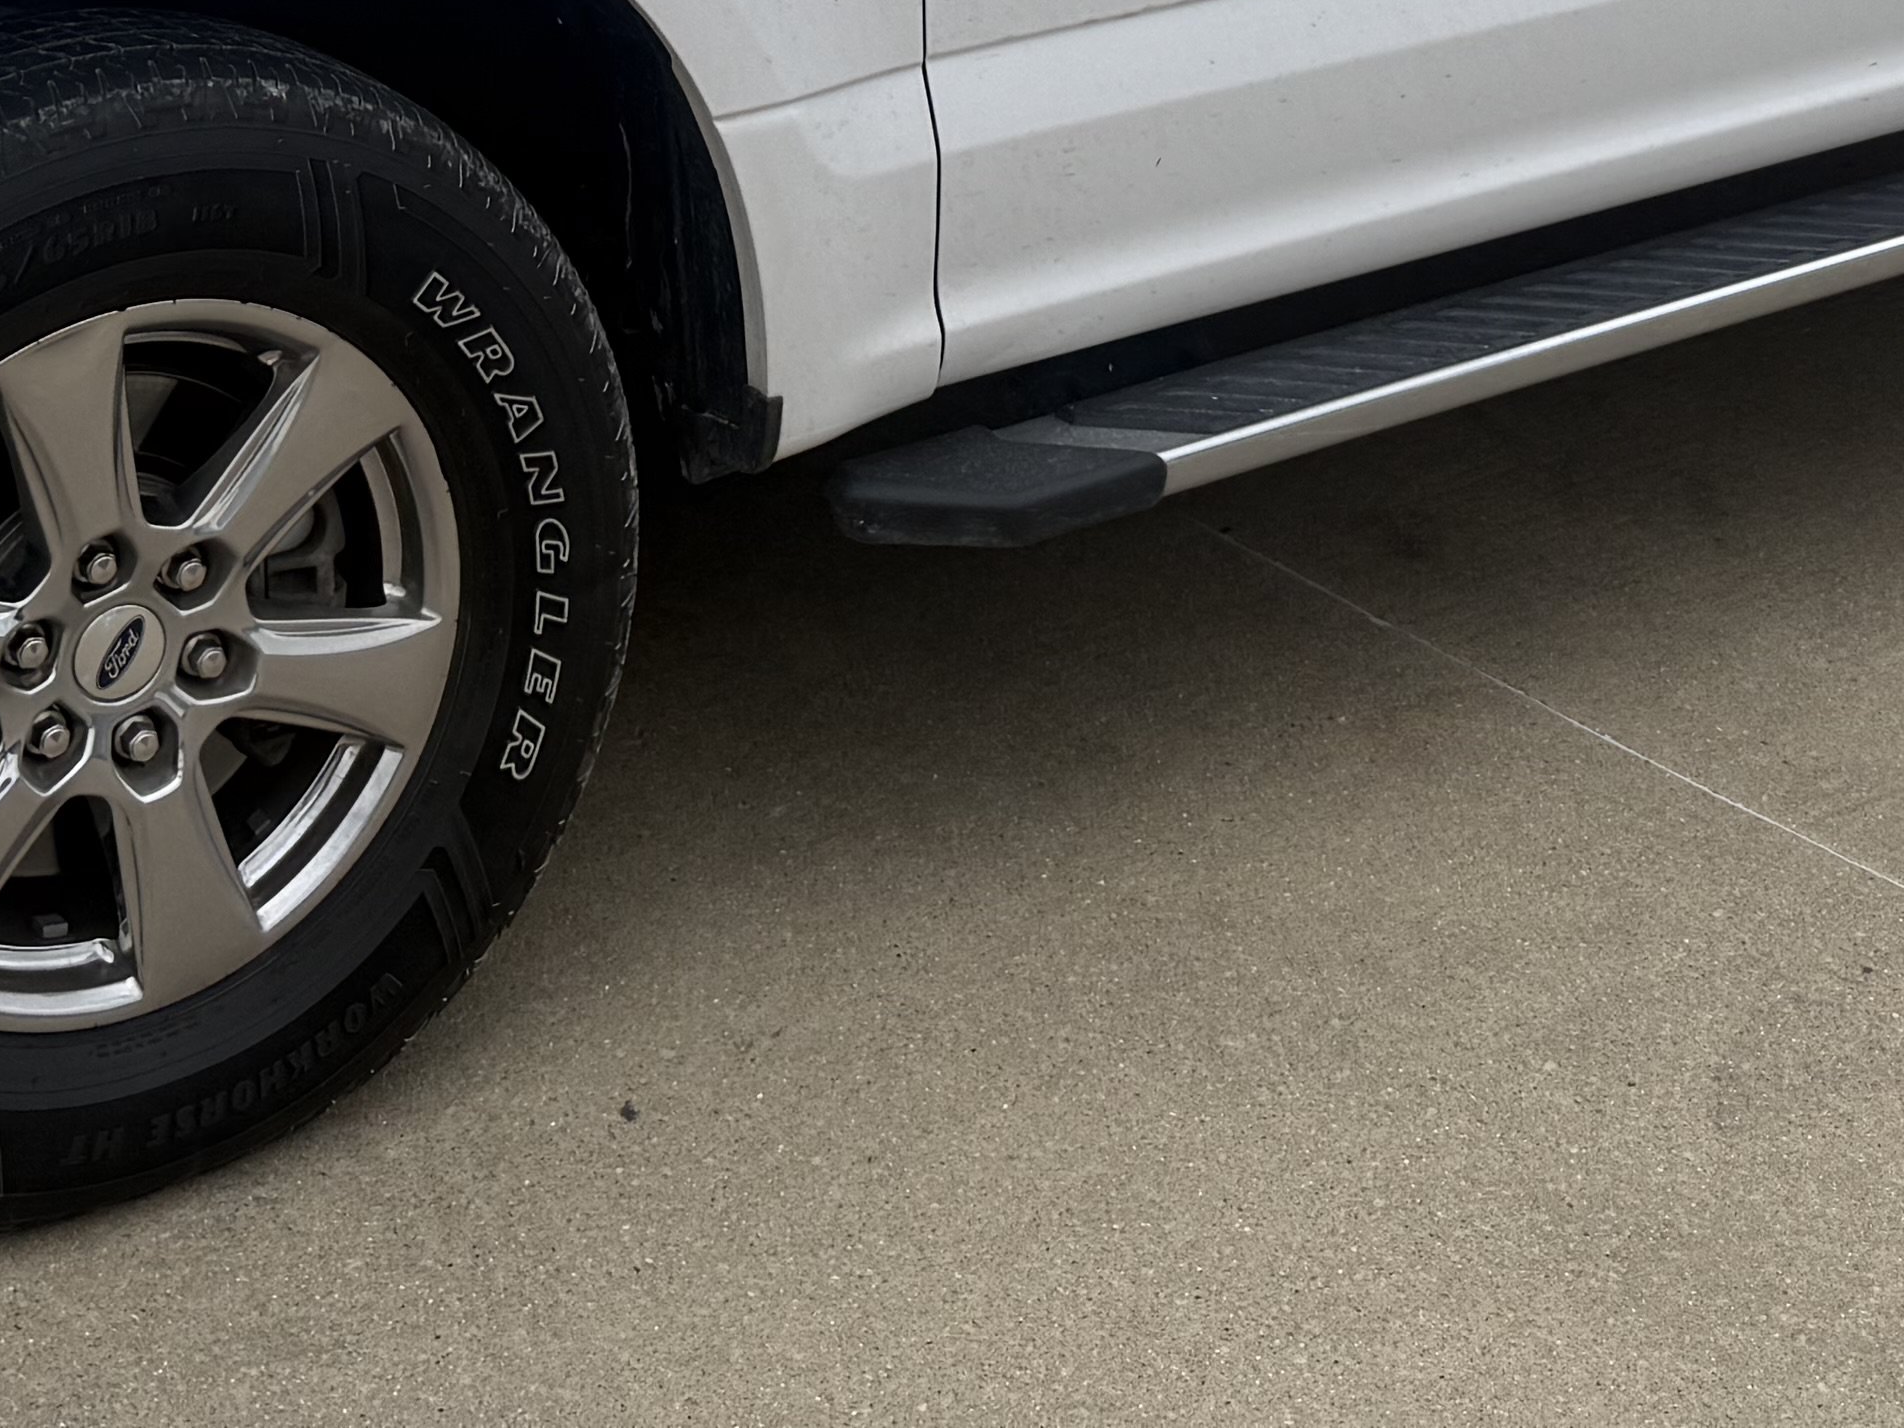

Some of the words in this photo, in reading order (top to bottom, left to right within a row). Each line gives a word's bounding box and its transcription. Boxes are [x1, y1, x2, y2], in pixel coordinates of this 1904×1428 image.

[411, 269, 570, 782] WRANGLER
[104, 627, 140, 679] Ford
[146, 972, 405, 1148] WORKHORSE
[59, 1125, 125, 1168] HT
